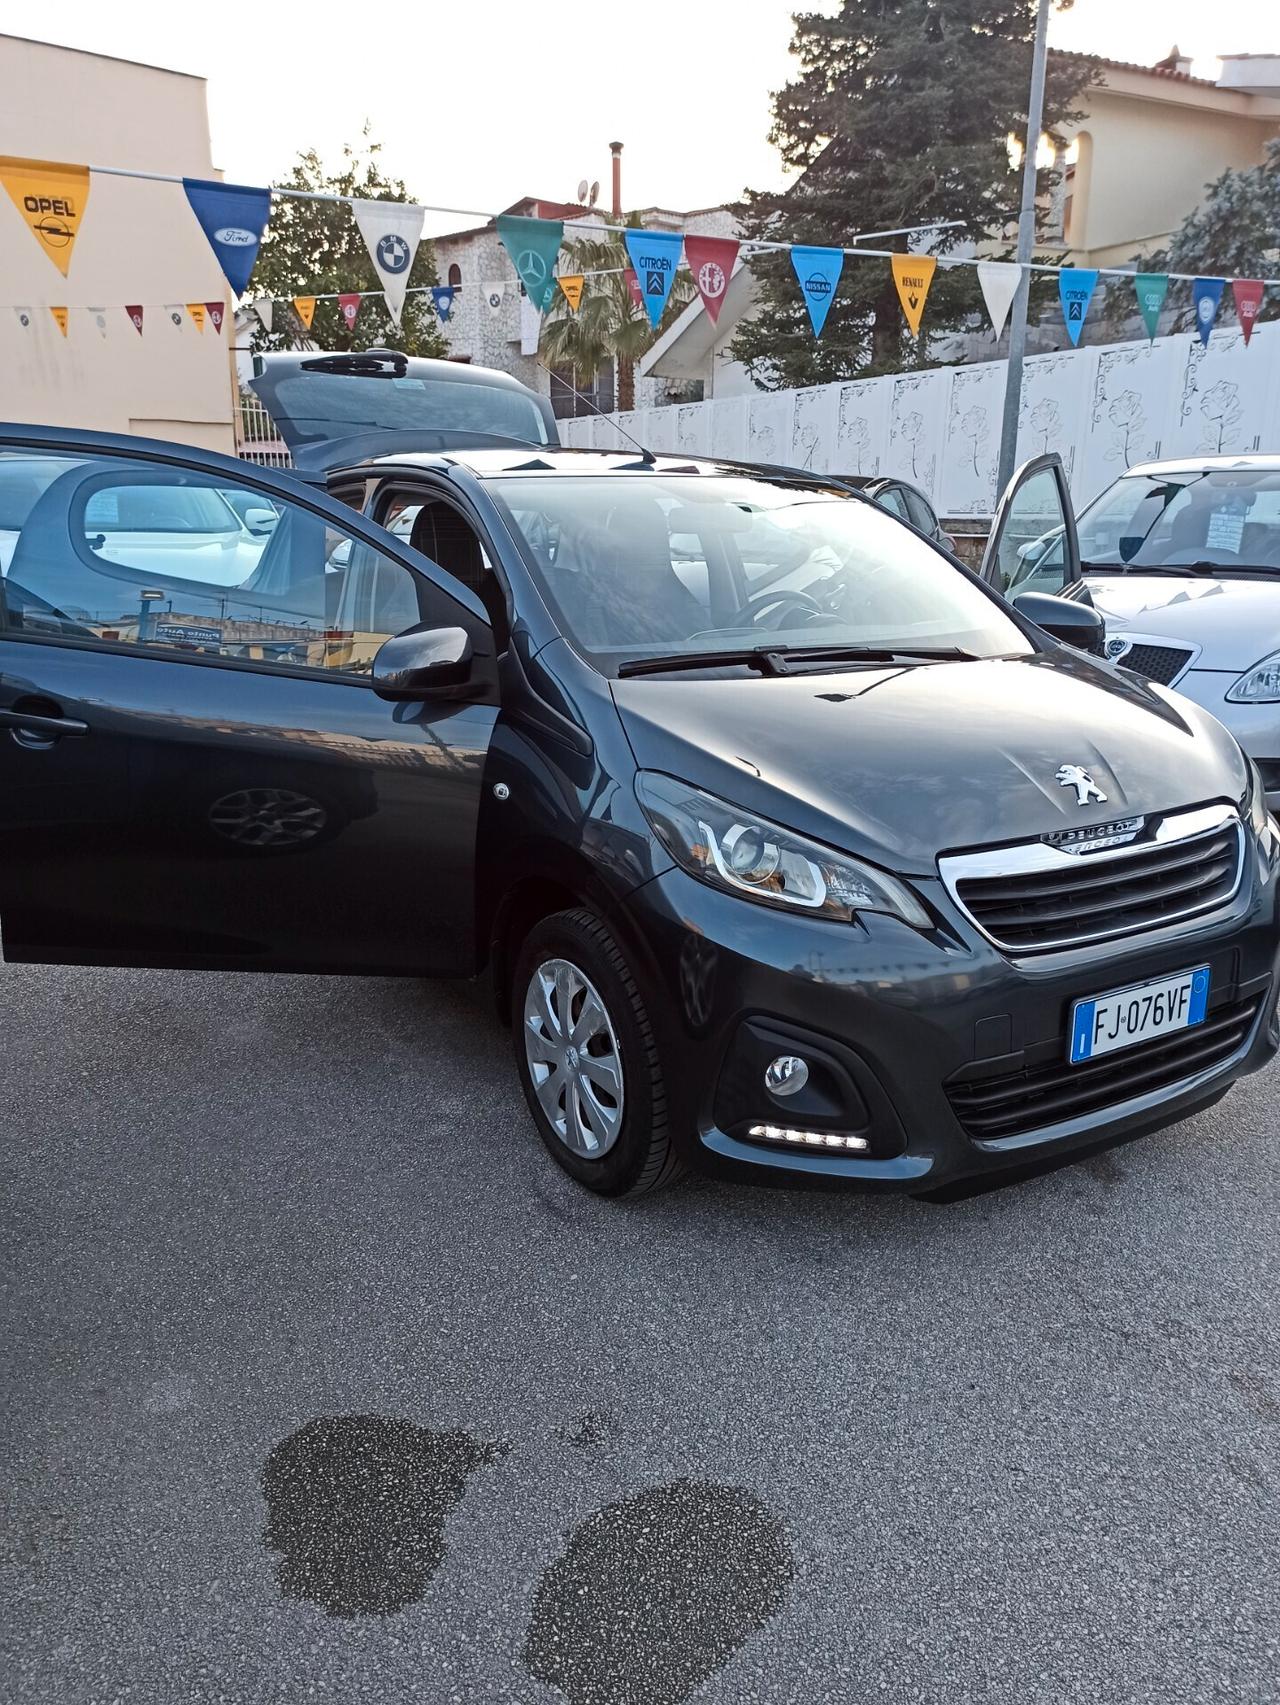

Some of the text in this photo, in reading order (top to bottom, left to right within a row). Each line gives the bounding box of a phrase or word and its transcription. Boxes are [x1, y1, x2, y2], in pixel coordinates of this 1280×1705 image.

[23, 196, 76, 218] OPEL
[224, 230, 249, 242] Ford
[639, 256, 672, 271] CITROËN
[806, 282, 831, 291] NISSAN
[902, 276, 924, 288] RENAULT
[1067, 821, 1132, 840] PEUGEOT
